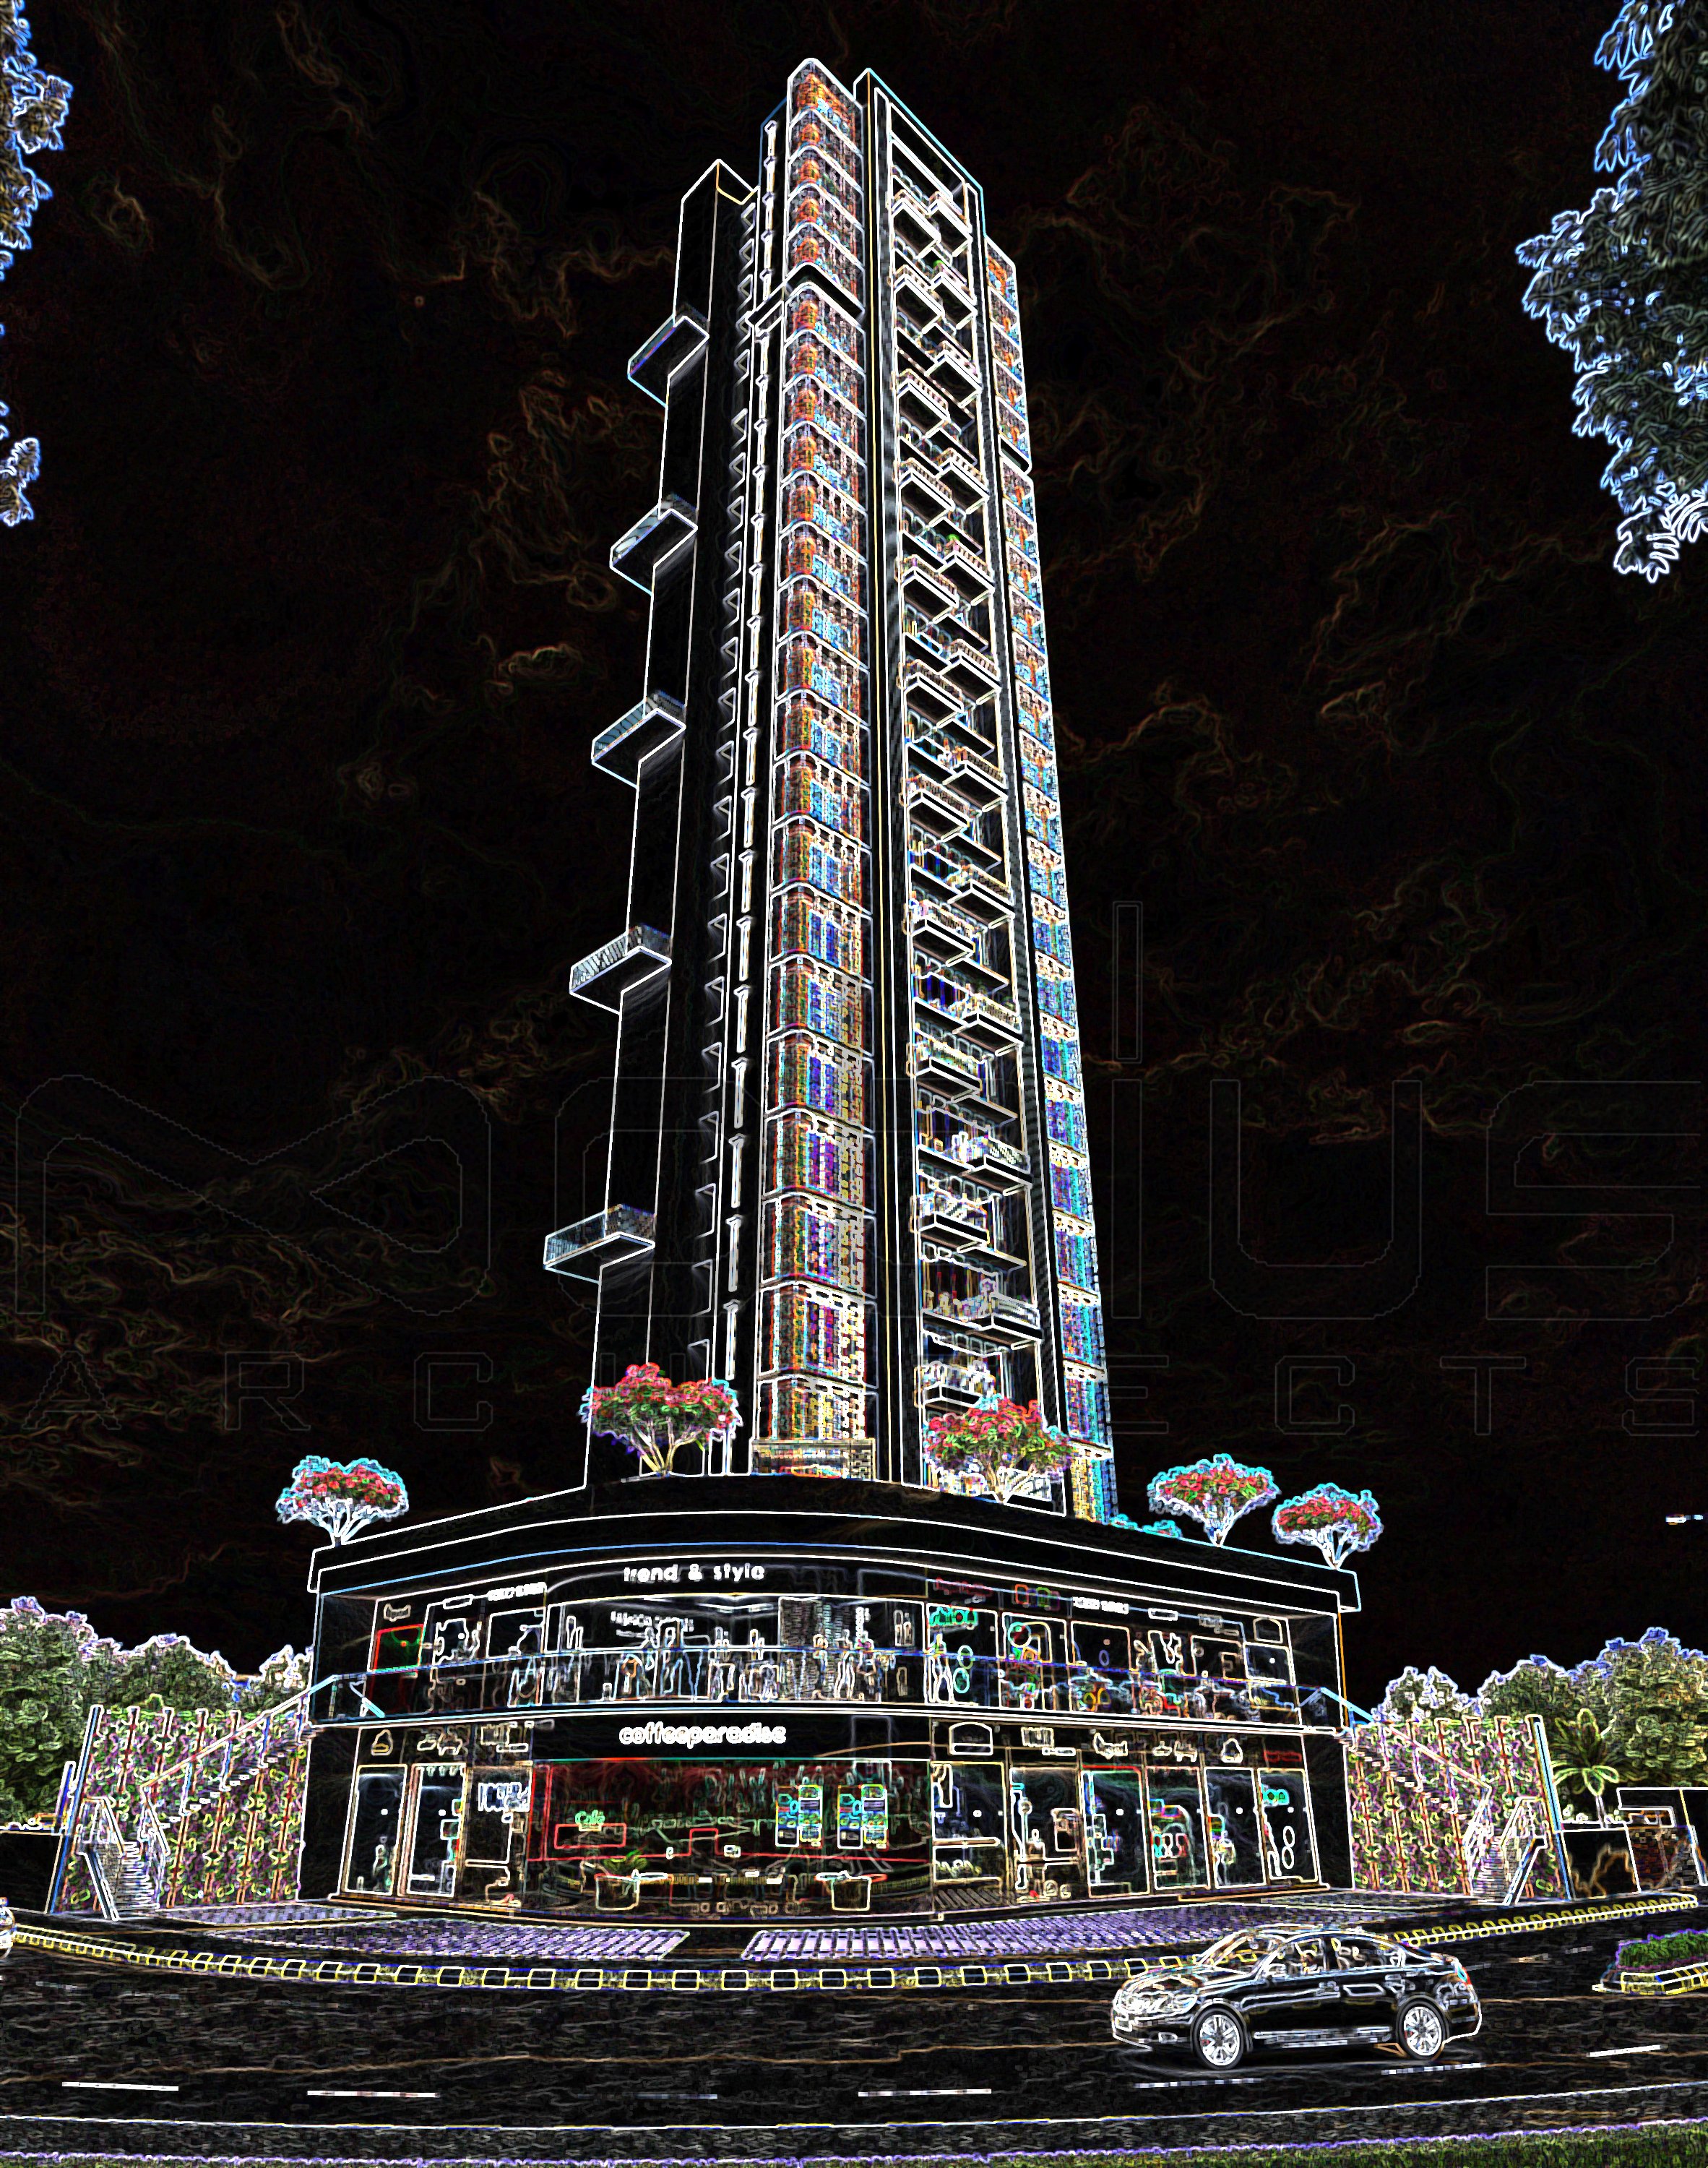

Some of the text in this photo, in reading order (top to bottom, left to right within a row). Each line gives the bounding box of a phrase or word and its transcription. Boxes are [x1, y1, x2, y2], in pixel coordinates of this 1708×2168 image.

[624, 1562, 765, 1583] trend & style
[618, 1721, 787, 1749] coffeeparadise
